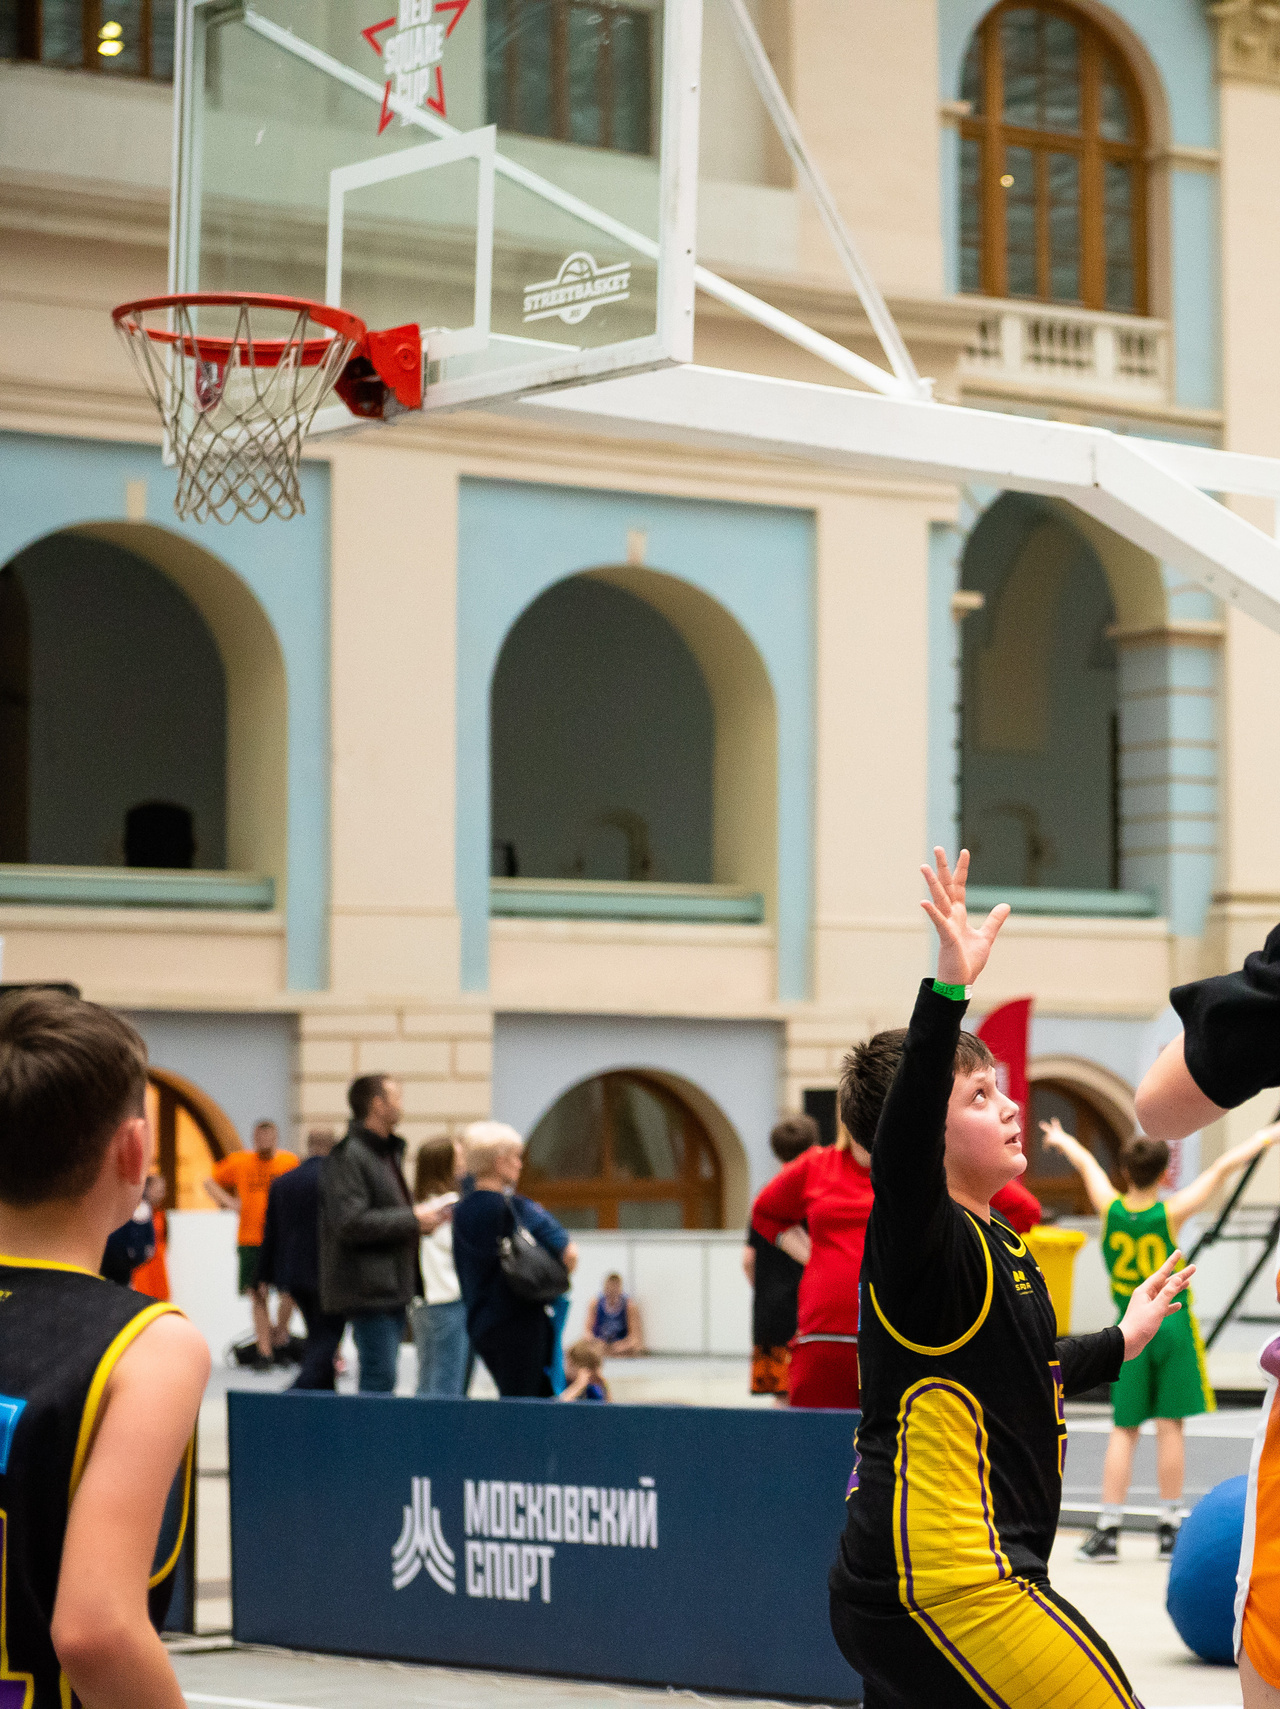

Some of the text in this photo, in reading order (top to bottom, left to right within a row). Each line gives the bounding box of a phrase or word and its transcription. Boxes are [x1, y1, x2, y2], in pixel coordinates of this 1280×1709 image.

[523, 272, 631, 312] STREETBASKET
[1109, 1231, 1167, 1281] 20
[464, 1476, 658, 1549] МОСКОВСКИЙ
[465, 1540, 555, 1603] СПОРТ
